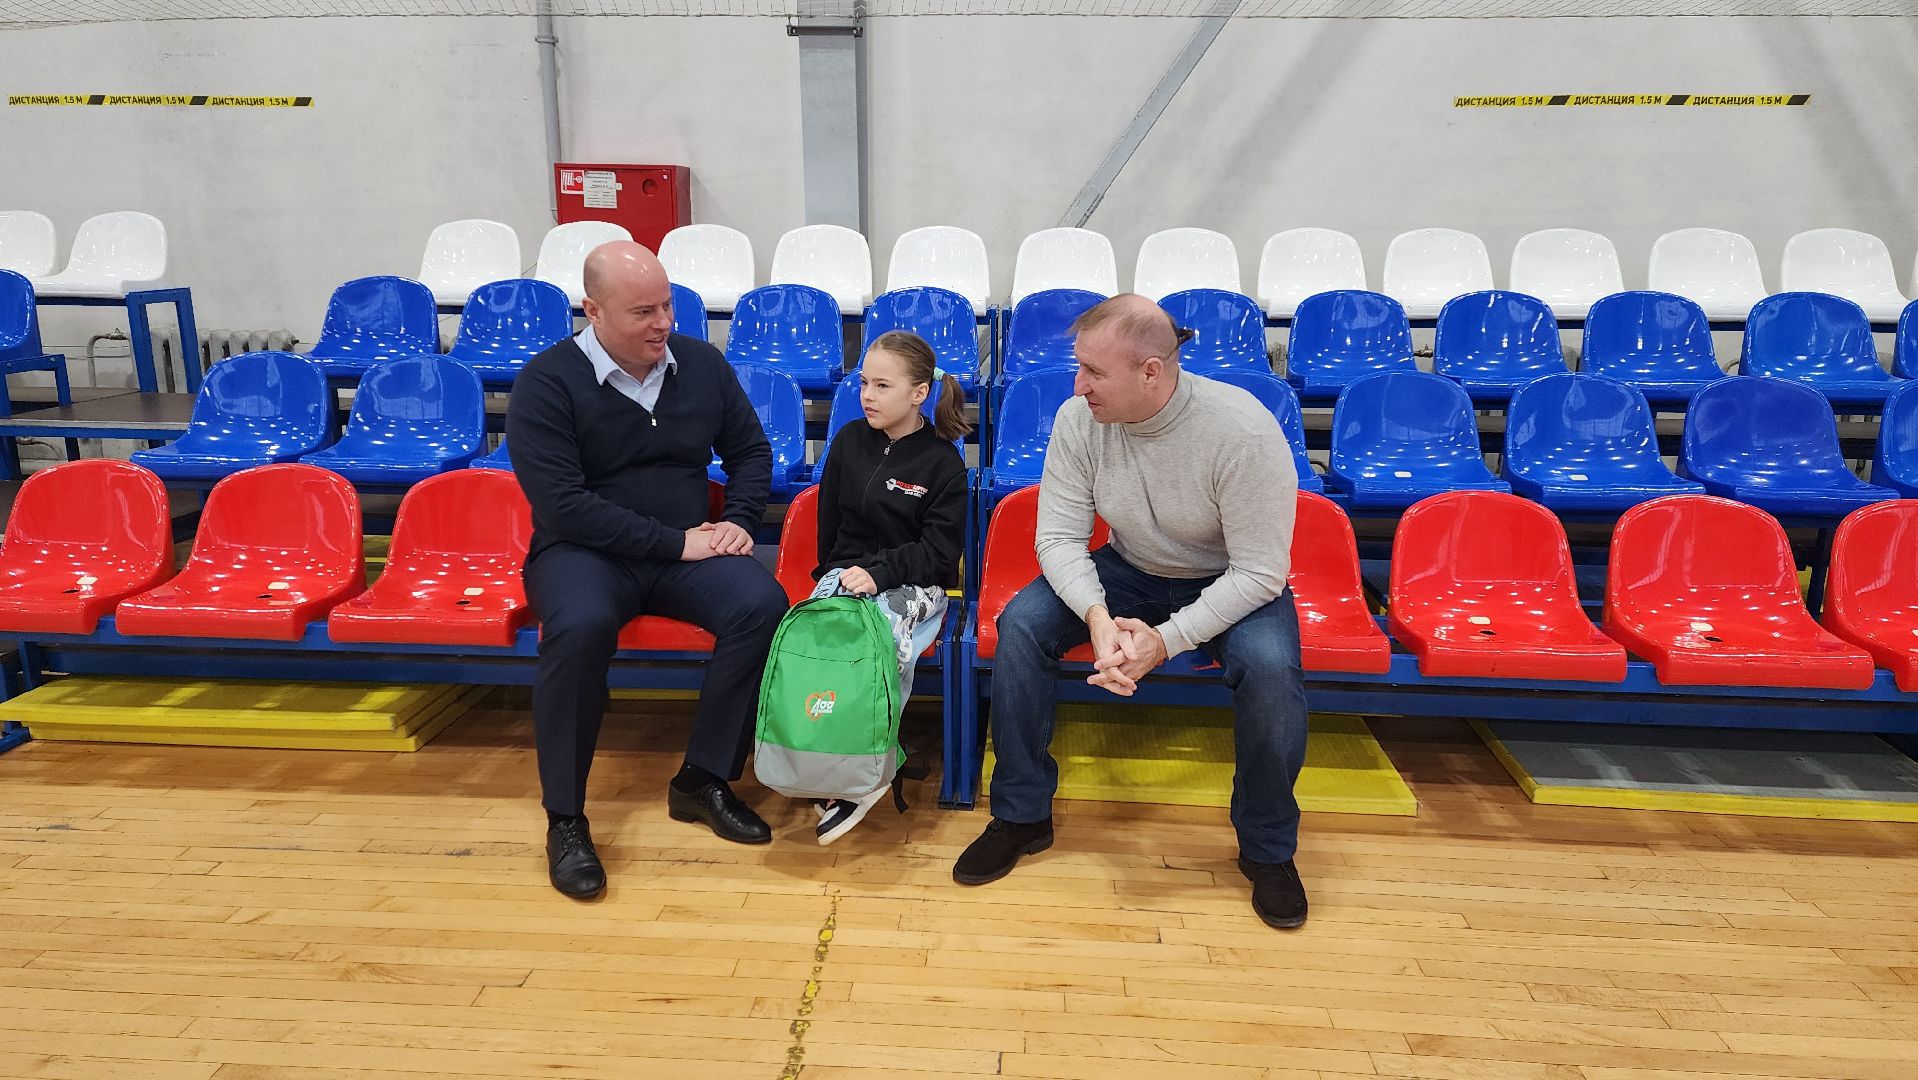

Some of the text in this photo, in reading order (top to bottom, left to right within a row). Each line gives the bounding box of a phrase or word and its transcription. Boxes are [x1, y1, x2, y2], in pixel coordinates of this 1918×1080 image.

[9, 96, 60, 105] ДИСТАНЦИЯ
[110, 96, 162, 105] ДИСТАНЦИЯ
[212, 97, 265, 106] ДИСТАНЦИЯ
[1455, 96, 1516, 107] ДИСТАНЦИЯ
[1574, 96, 1635, 105] ДИСТАНЦИЯ
[1693, 96, 1755, 105] ДИСТАНЦИЯ
